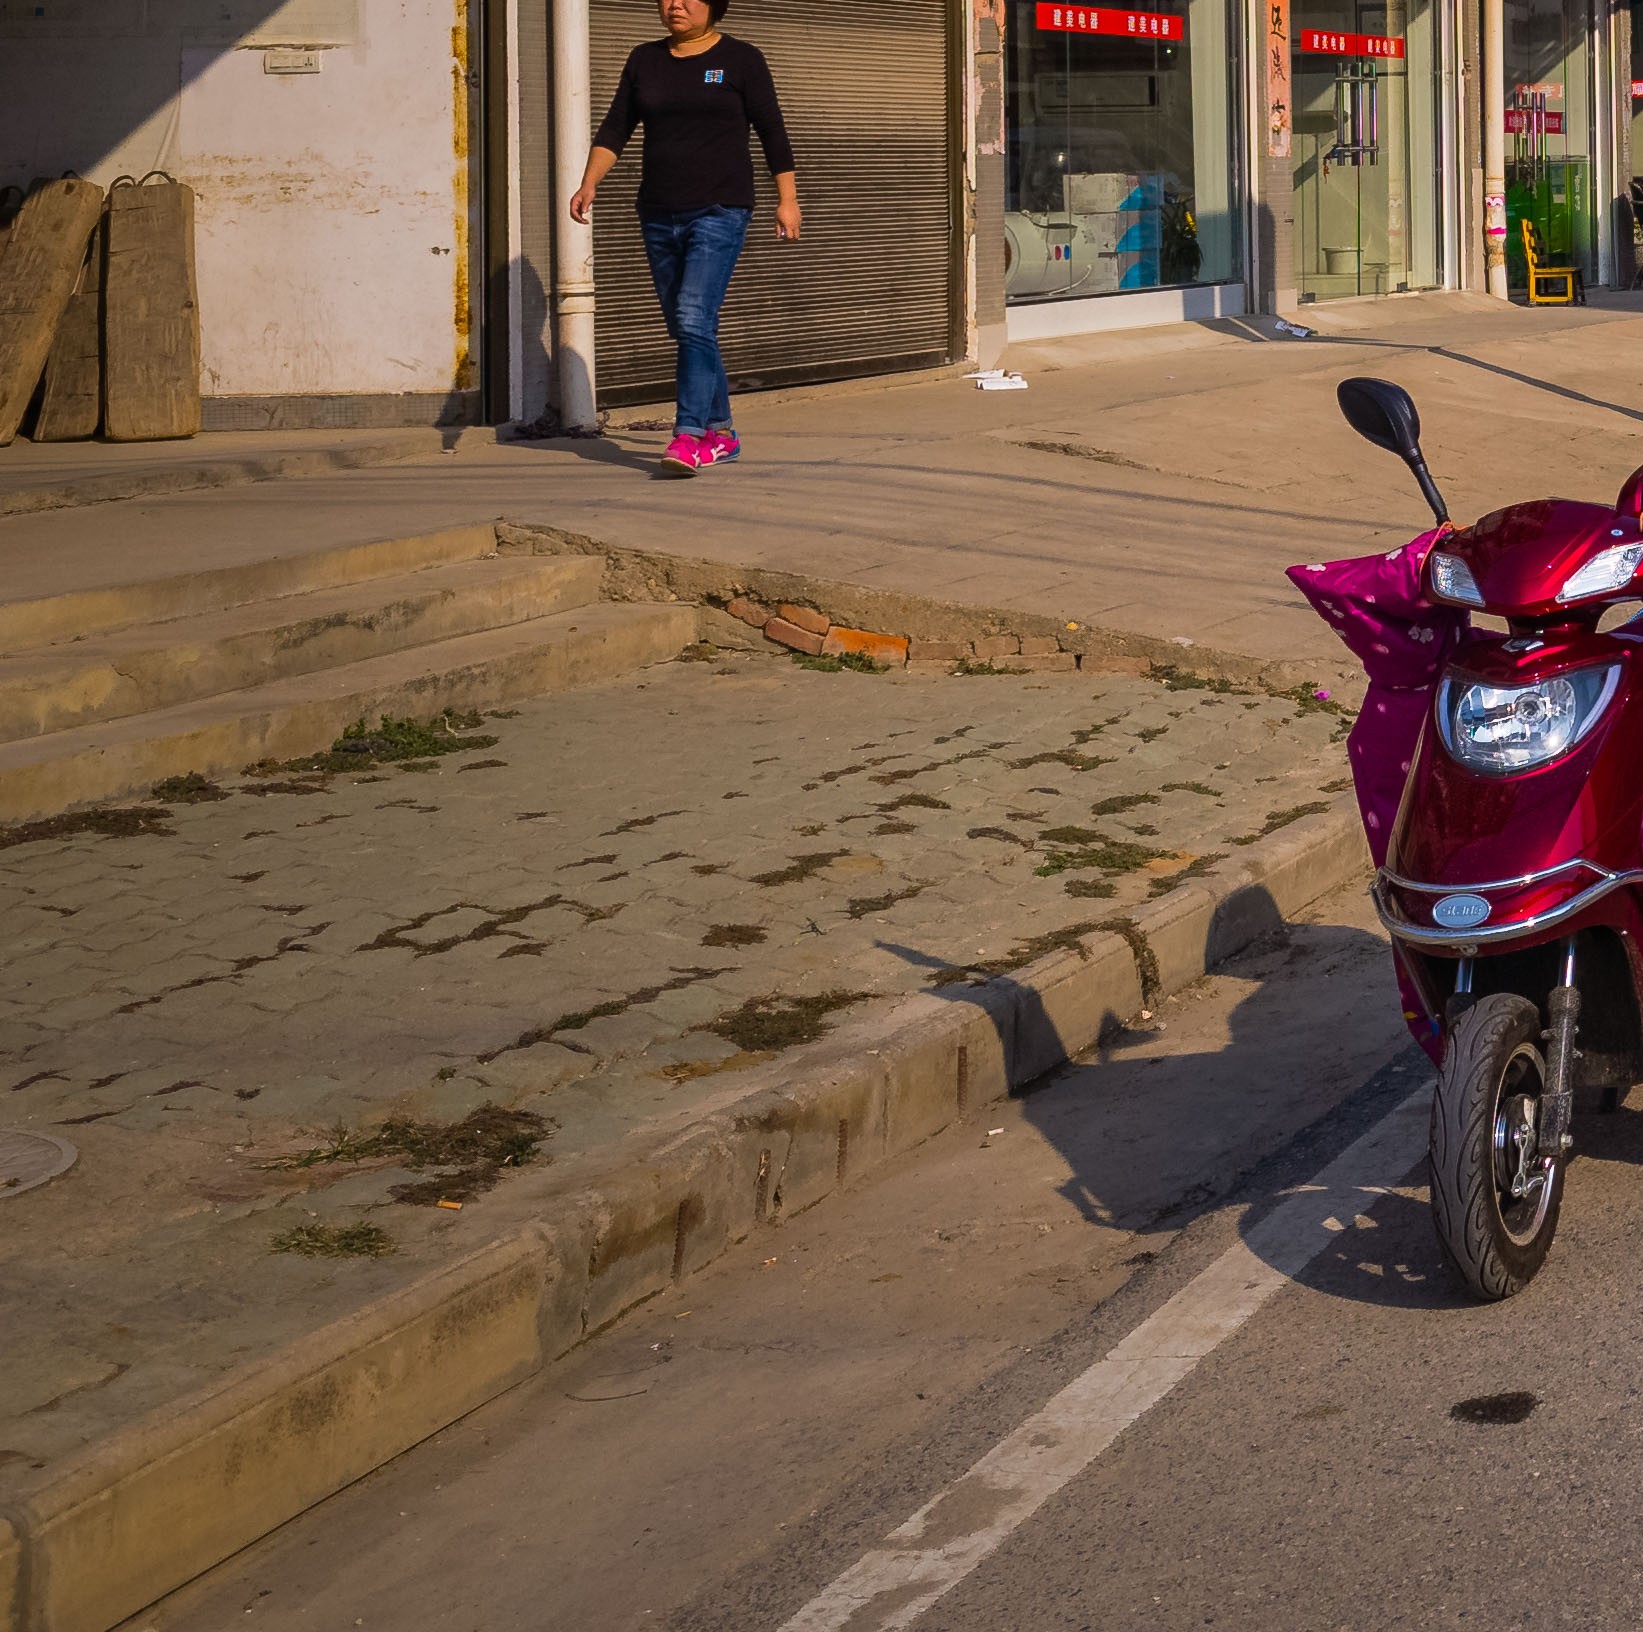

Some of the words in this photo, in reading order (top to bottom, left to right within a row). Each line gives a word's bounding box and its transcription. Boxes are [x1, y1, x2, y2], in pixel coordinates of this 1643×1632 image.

[1053, 8, 1099, 30] 建美电器
[1127, 15, 1170, 36] 建美电器
[1312, 33, 1345, 52] 建美电器
